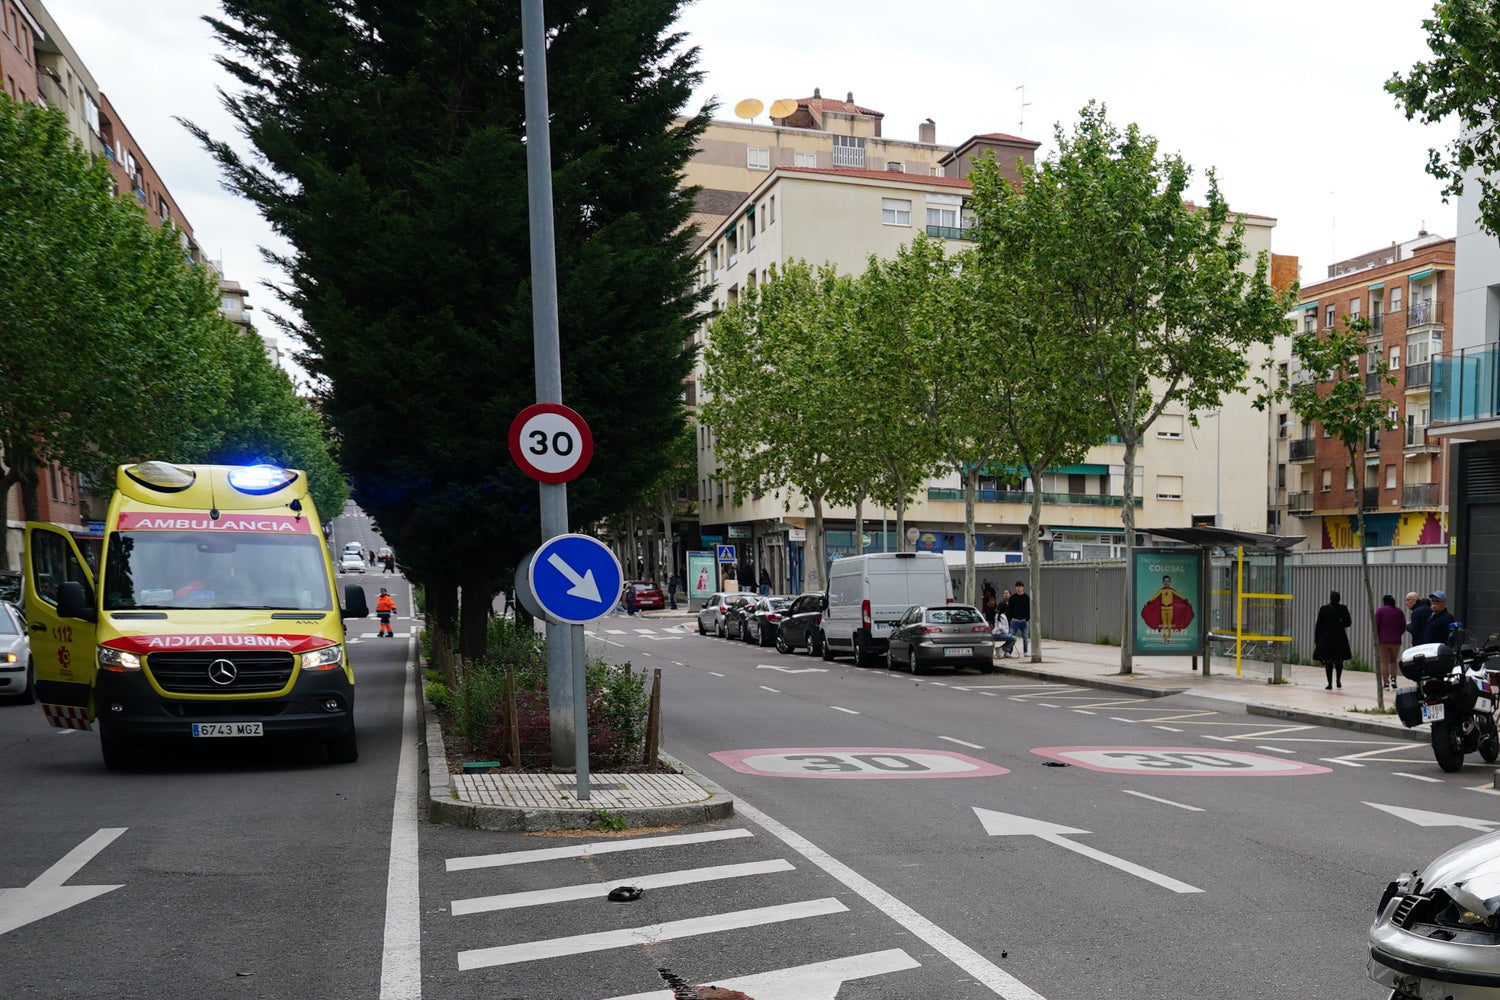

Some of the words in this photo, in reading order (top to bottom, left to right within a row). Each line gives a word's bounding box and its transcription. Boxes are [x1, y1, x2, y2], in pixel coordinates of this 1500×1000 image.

[528, 430, 574, 456] 30
[135, 518, 297, 532] AMBULANCIA
[1148, 564, 1185, 572] COLOSAL
[57, 626, 73, 643] 112
[201, 725, 233, 735] 6743
[237, 724, 261, 735] MGZ
[783, 754, 932, 772] 30
[1102, 753, 1255, 769] 30
